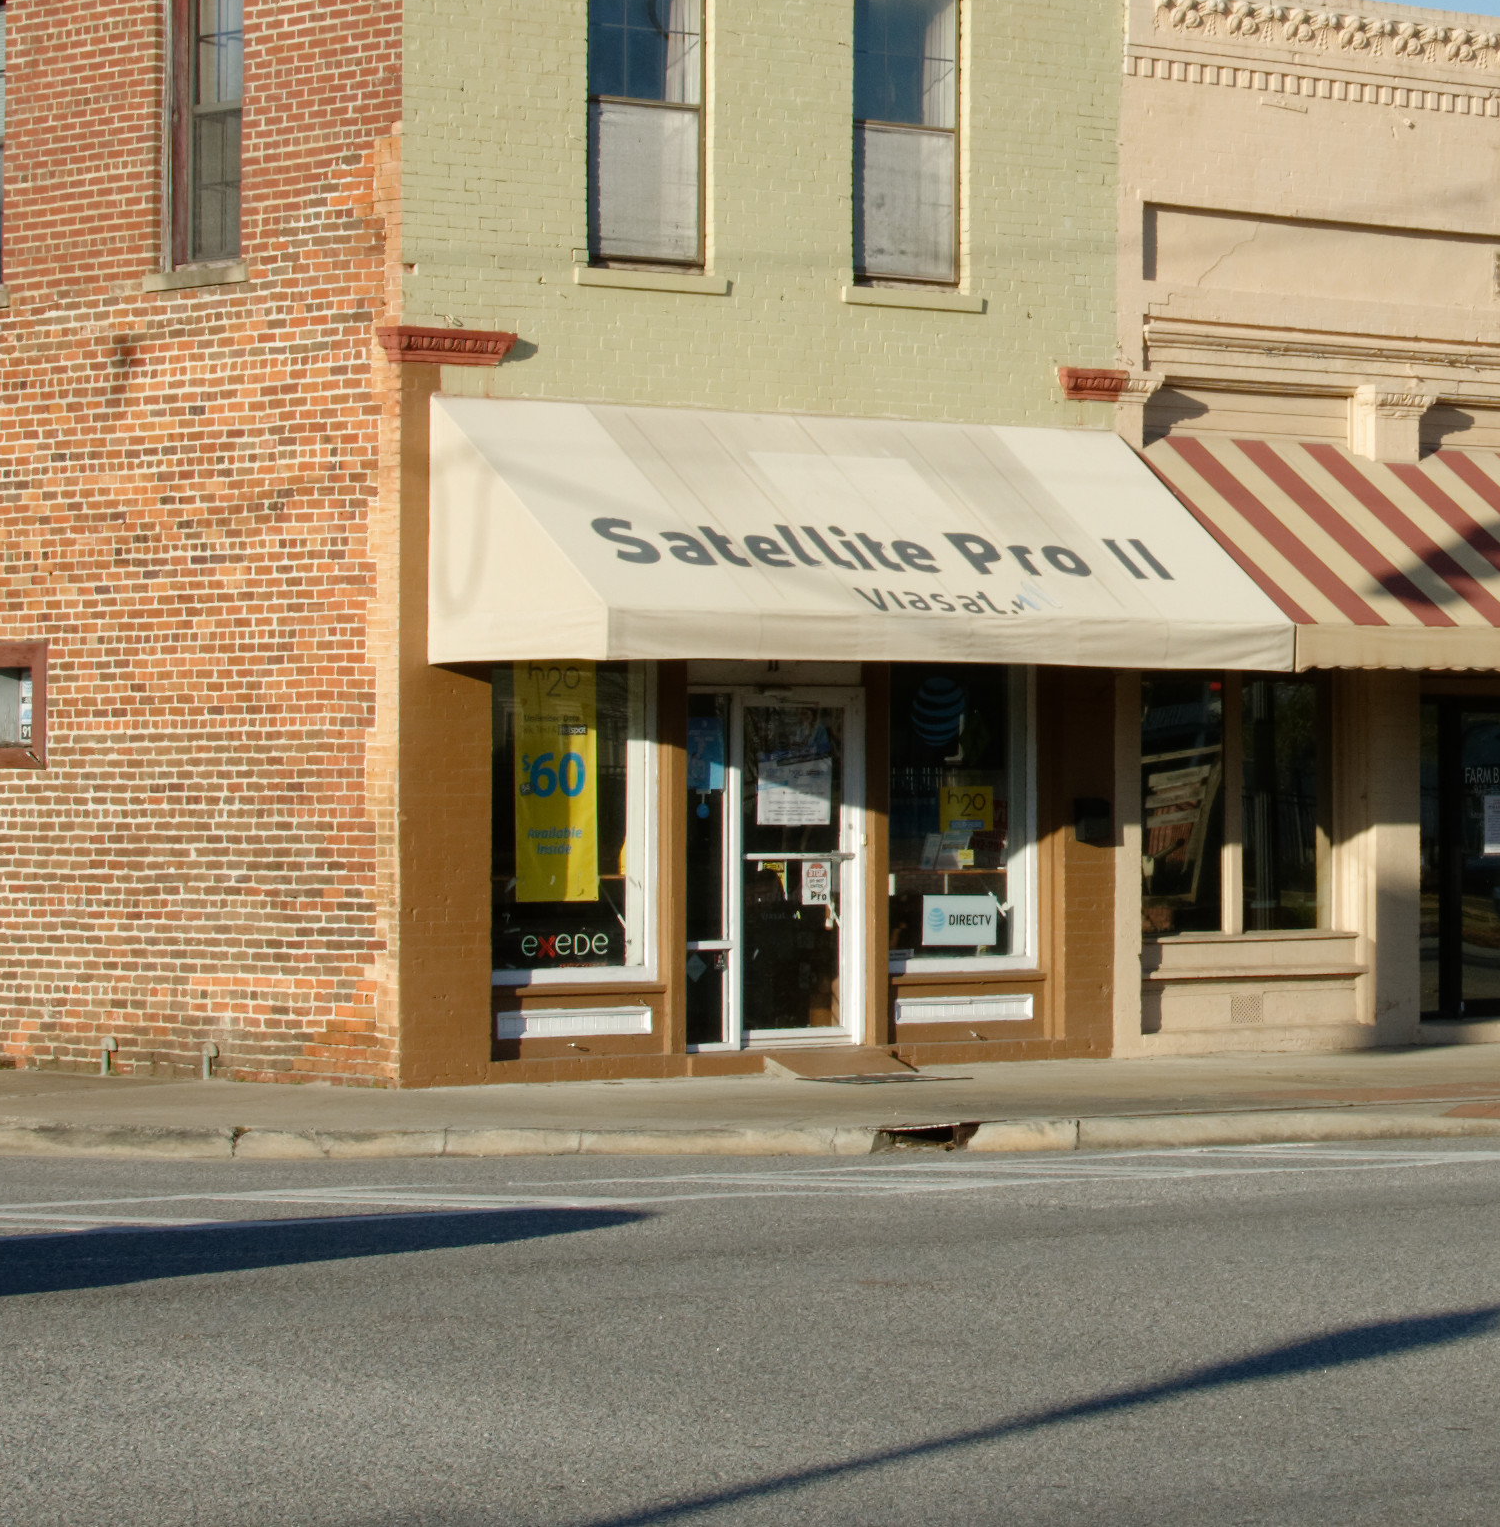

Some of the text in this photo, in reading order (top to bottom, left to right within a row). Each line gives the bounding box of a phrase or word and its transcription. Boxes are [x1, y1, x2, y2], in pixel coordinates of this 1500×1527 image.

[590, 516, 1176, 581] Satellite Pro II
[1464, 767, 1492, 784] FARM
[527, 826, 583, 839] Available
[536, 843, 572, 855] Inside
[810, 891, 827, 901] Pro
[948, 914, 992, 926] DIRECTV
